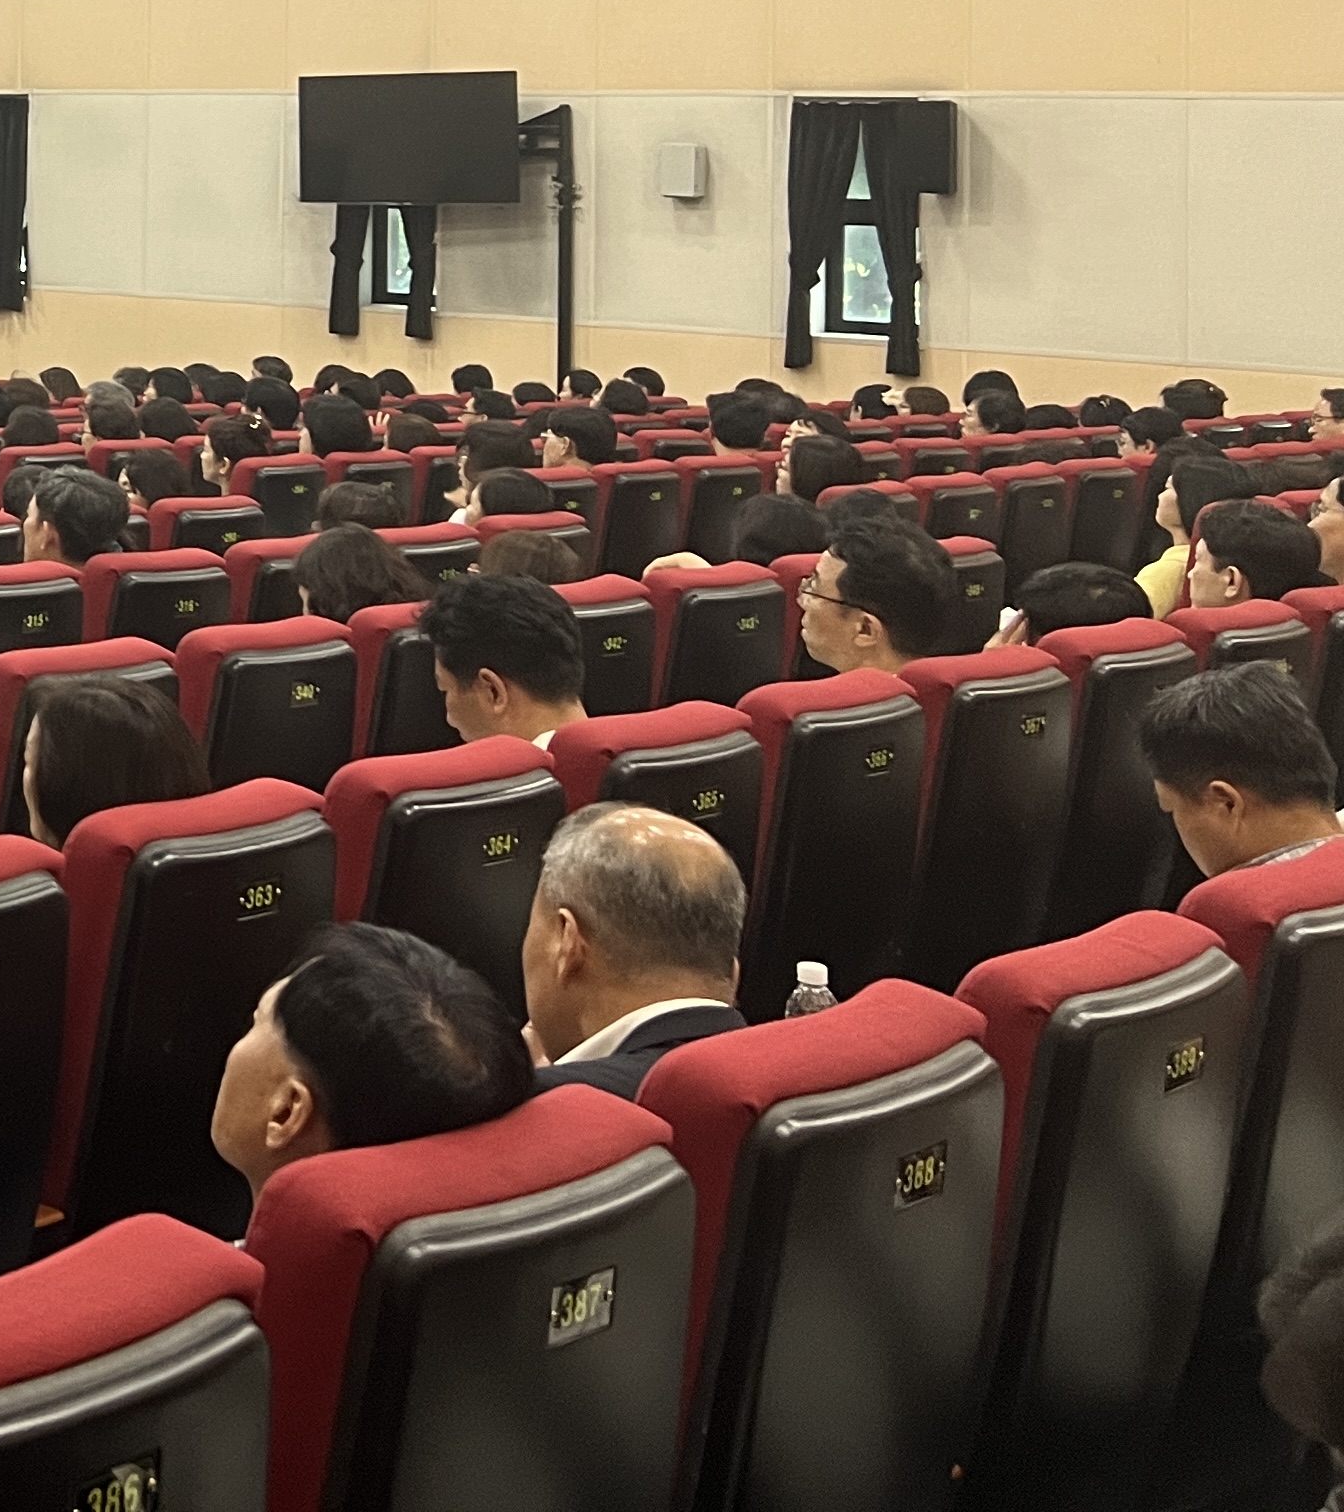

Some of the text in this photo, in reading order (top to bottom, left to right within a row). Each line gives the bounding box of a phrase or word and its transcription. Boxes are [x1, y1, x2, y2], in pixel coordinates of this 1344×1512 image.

[487, 834, 511, 856] 364
[244, 884, 273, 909] 363
[560, 1283, 602, 1328] 387
